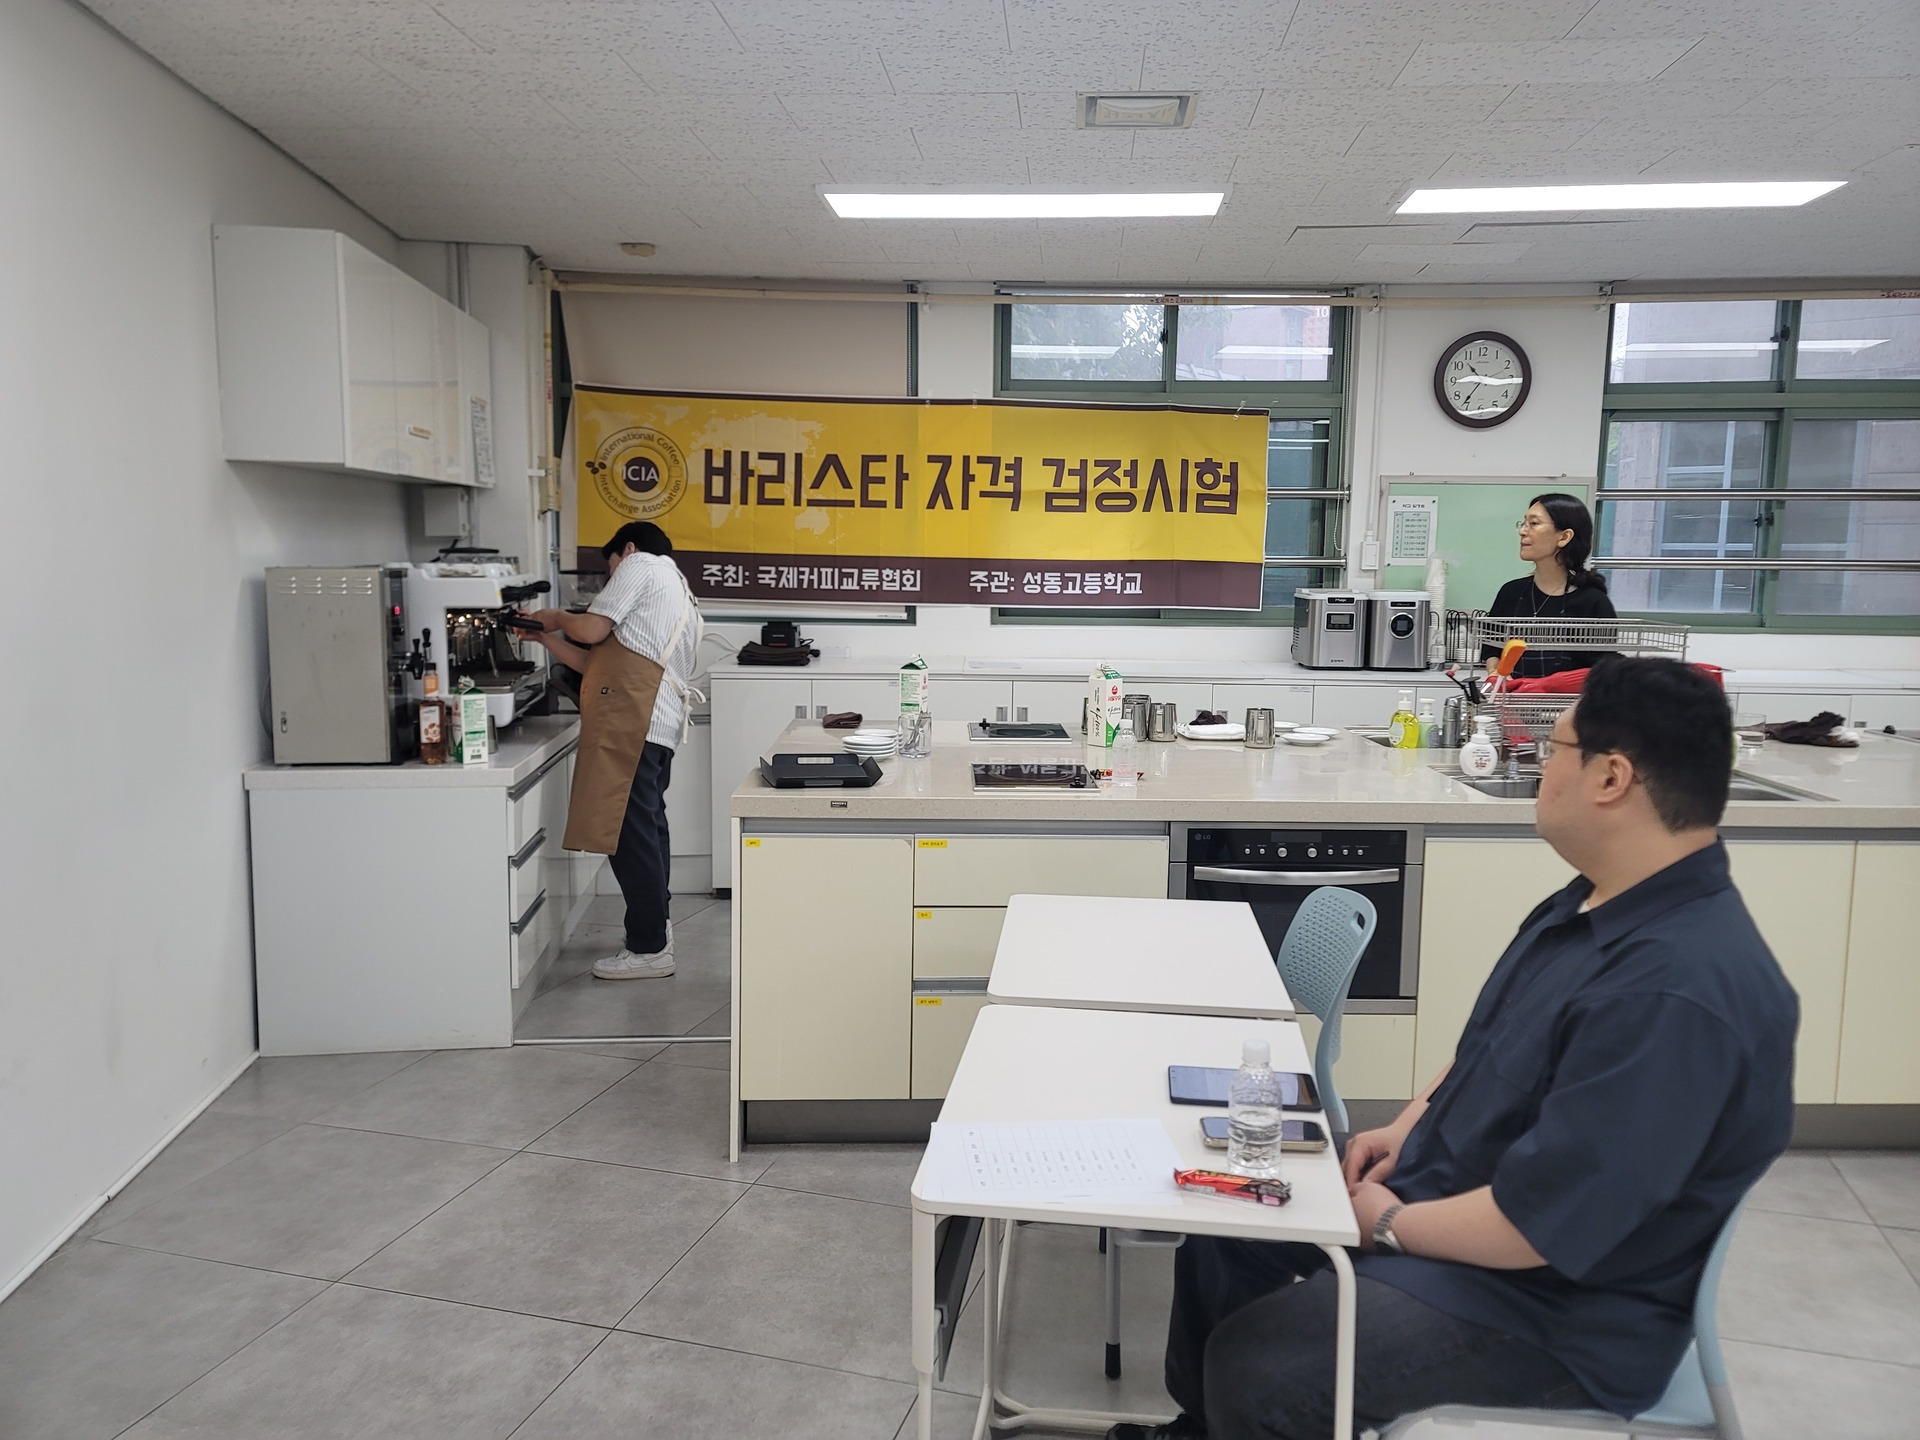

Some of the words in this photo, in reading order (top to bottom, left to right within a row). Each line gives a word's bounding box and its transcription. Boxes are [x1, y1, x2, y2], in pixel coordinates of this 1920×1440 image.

[1315, 307, 1329, 318] 10
[1464, 350, 1473, 360] 11
[1478, 347, 1489, 357] 12
[1495, 350, 1500, 360] 1
[1453, 361, 1464, 371] 10
[1504, 360, 1511, 370] 2
[1450, 376, 1457, 386] 9
[1453, 390, 1461, 400] 8
[1501, 389, 1509, 399] 4
[600, 431, 655, 462] International
[656, 437, 681, 465] Coffee
[622, 465, 659, 482] ICIA
[703, 448, 910, 510] 바리스타
[925, 454, 1023, 512] 자격
[1041, 457, 1240, 516] 검정시험
[599, 474, 640, 514] Interchange
[641, 479, 682, 513] Association
[701, 563, 750, 588] 주최:
[756, 565, 922, 592] 국제커피교류협회
[968, 570, 1015, 593] 주관:
[1022, 571, 1143, 595] 성동고등학교
